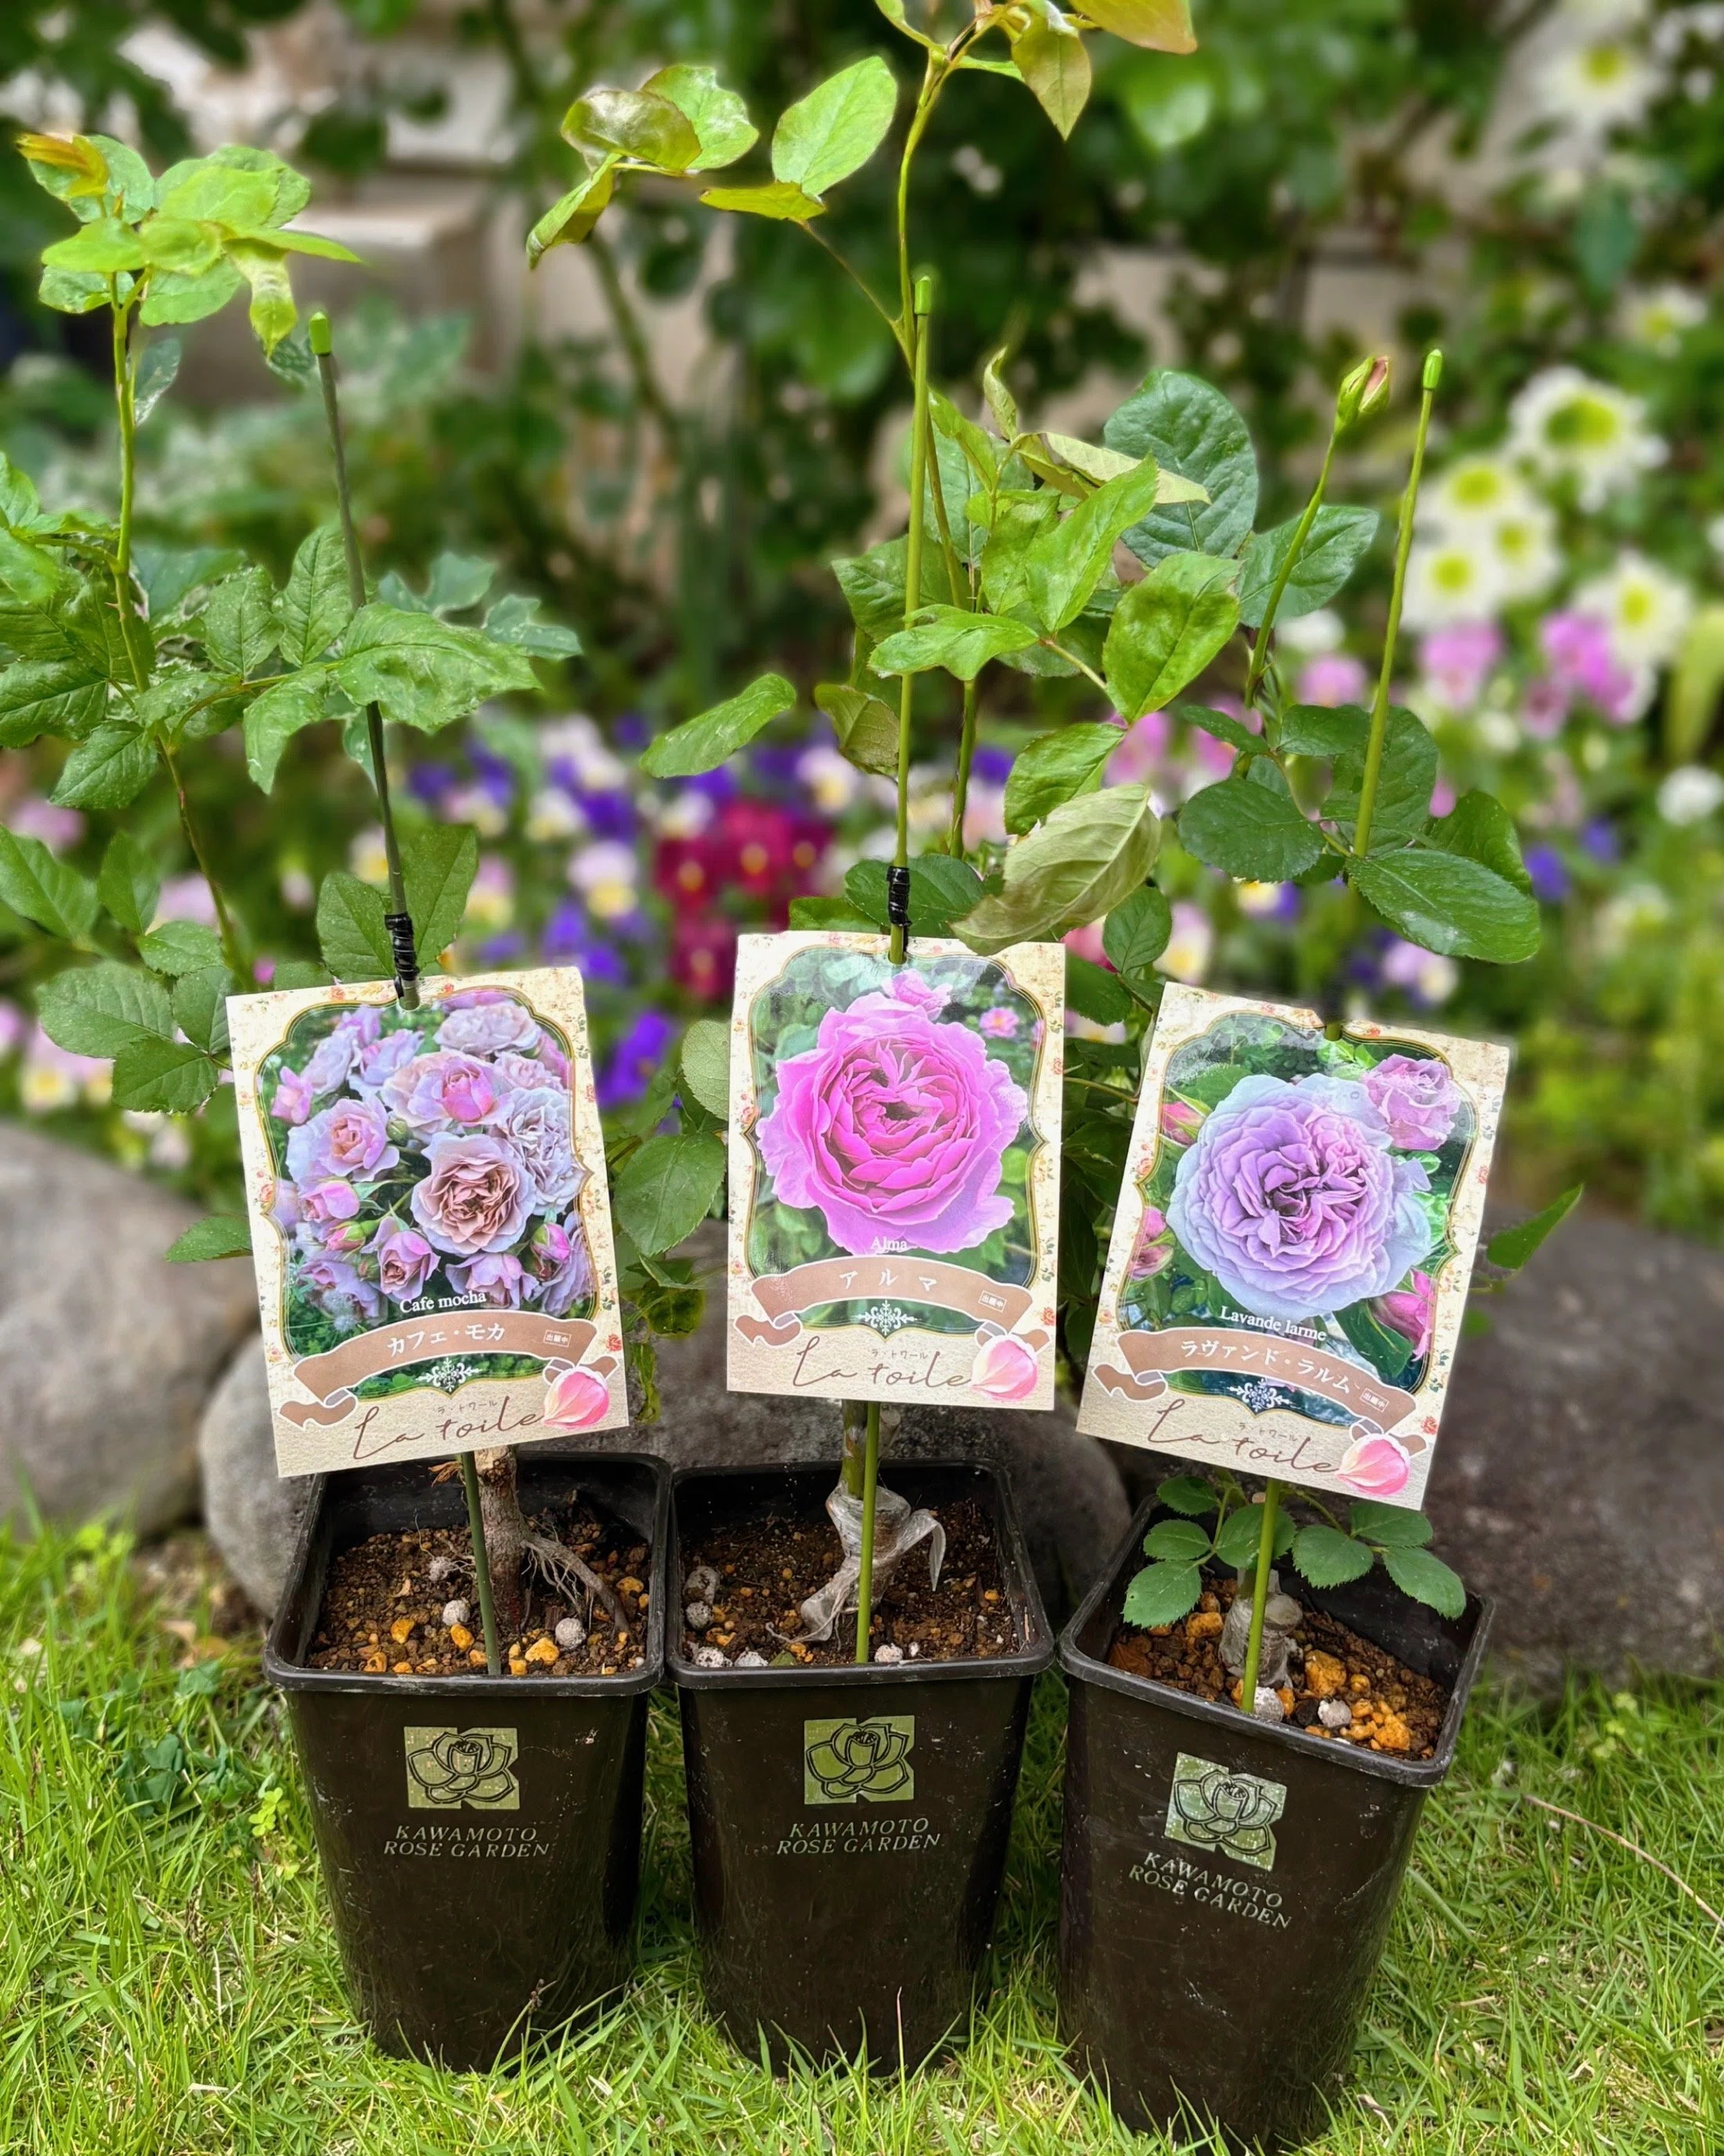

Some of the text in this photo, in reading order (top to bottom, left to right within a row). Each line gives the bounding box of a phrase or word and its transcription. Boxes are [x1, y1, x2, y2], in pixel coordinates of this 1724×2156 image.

[871, 1235, 908, 1252] Alma
[839, 1268, 937, 1291] アルマ
[438, 1291, 487, 1309] mocha
[1220, 1306, 1327, 1342] Lavande larme
[792, 1335, 972, 1388] La toile
[353, 1396, 545, 1460] La toile
[1147, 1399, 1340, 1472] La toile
[395, 1825, 537, 1842] KAWAMOTO
[788, 1818, 929, 1839] KAWAMOTO
[384, 1841, 550, 1858] ROSE GARDEN
[776, 1833, 940, 1855] ROSE GARDEN
[1143, 1851, 1283, 1909] KAWAMOTO
[1128, 1865, 1292, 1930] ROSE GARDEN
